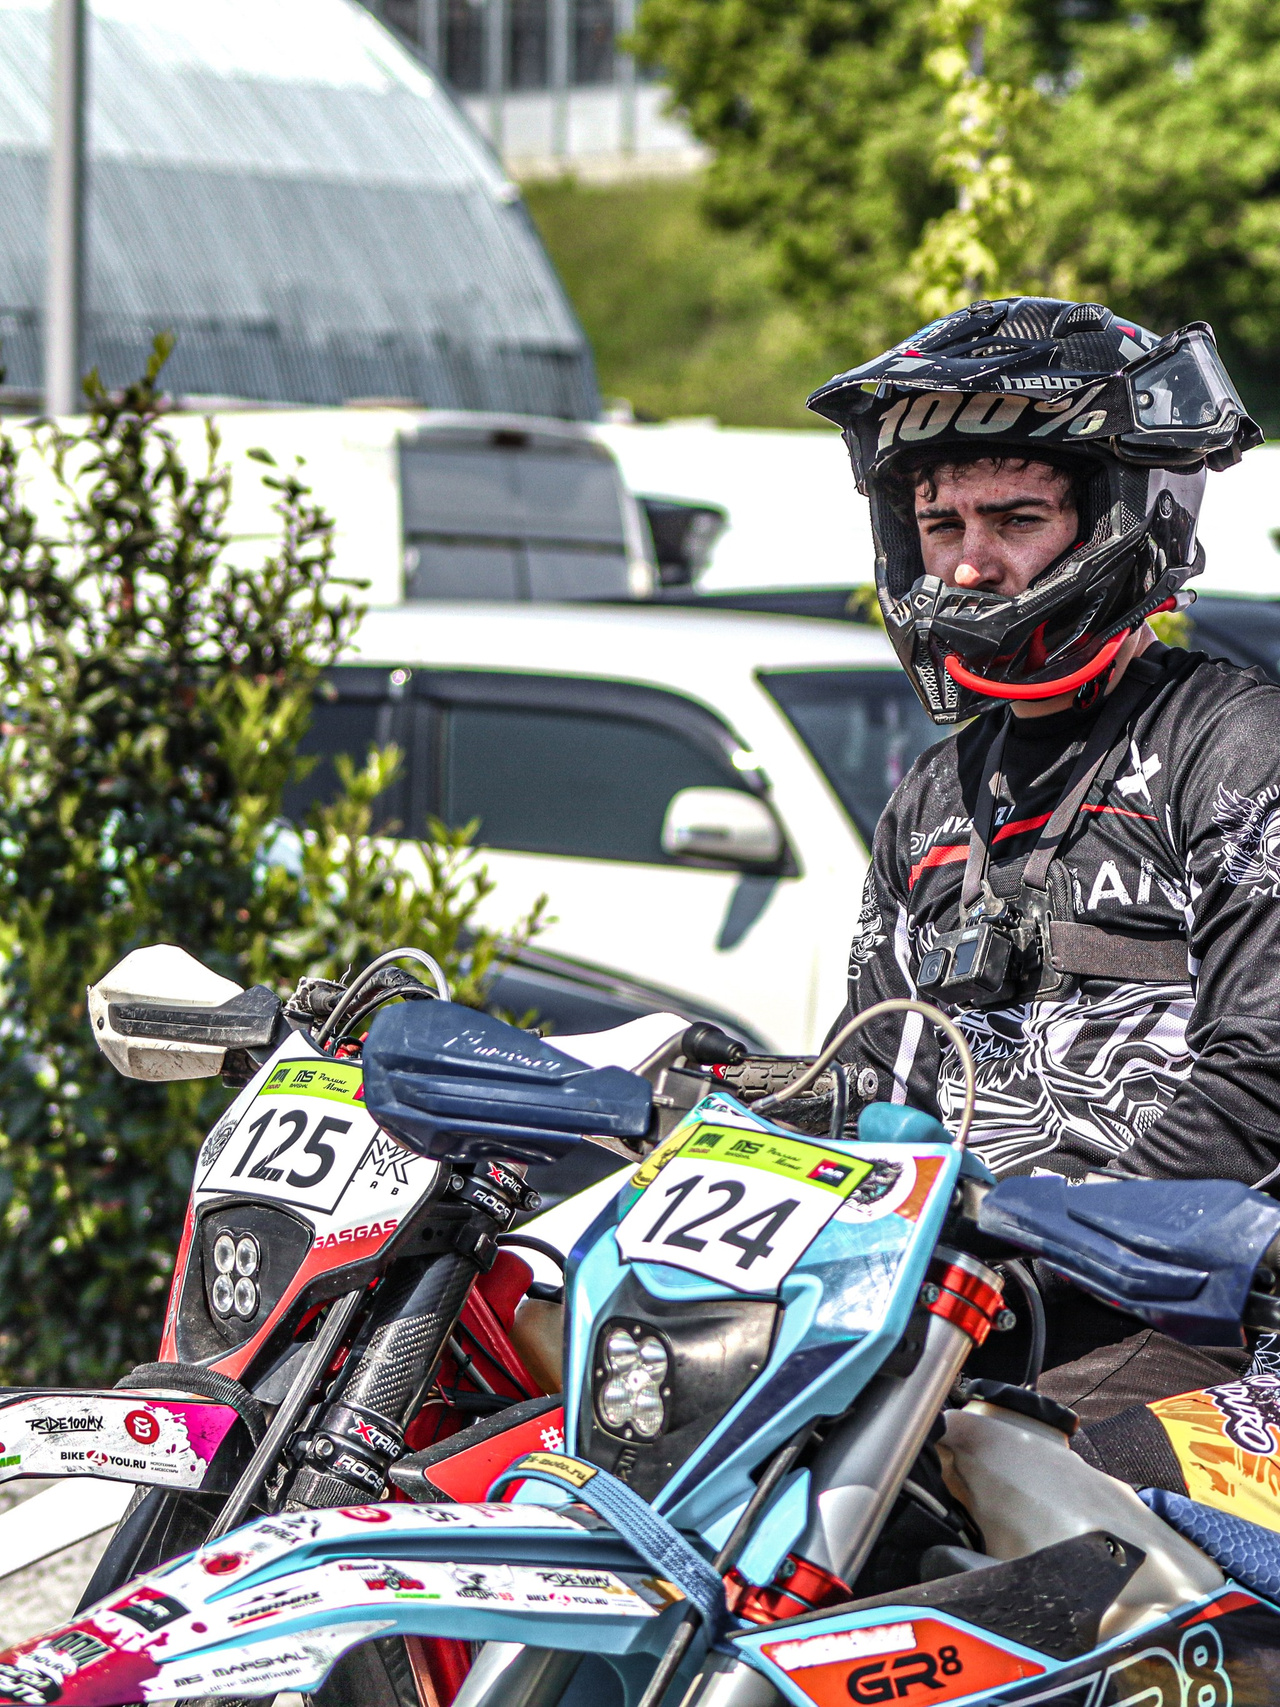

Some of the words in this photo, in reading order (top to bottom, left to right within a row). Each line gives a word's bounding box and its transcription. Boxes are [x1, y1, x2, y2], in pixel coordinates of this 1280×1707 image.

[877, 383, 1108, 451] 100%
[230, 1108, 353, 1188] 125
[313, 1219, 398, 1250] GASGAS
[642, 1174, 801, 1270] 124
[212, 1651, 310, 1678] MARSHAL
[847, 1645, 963, 1705] GR8
